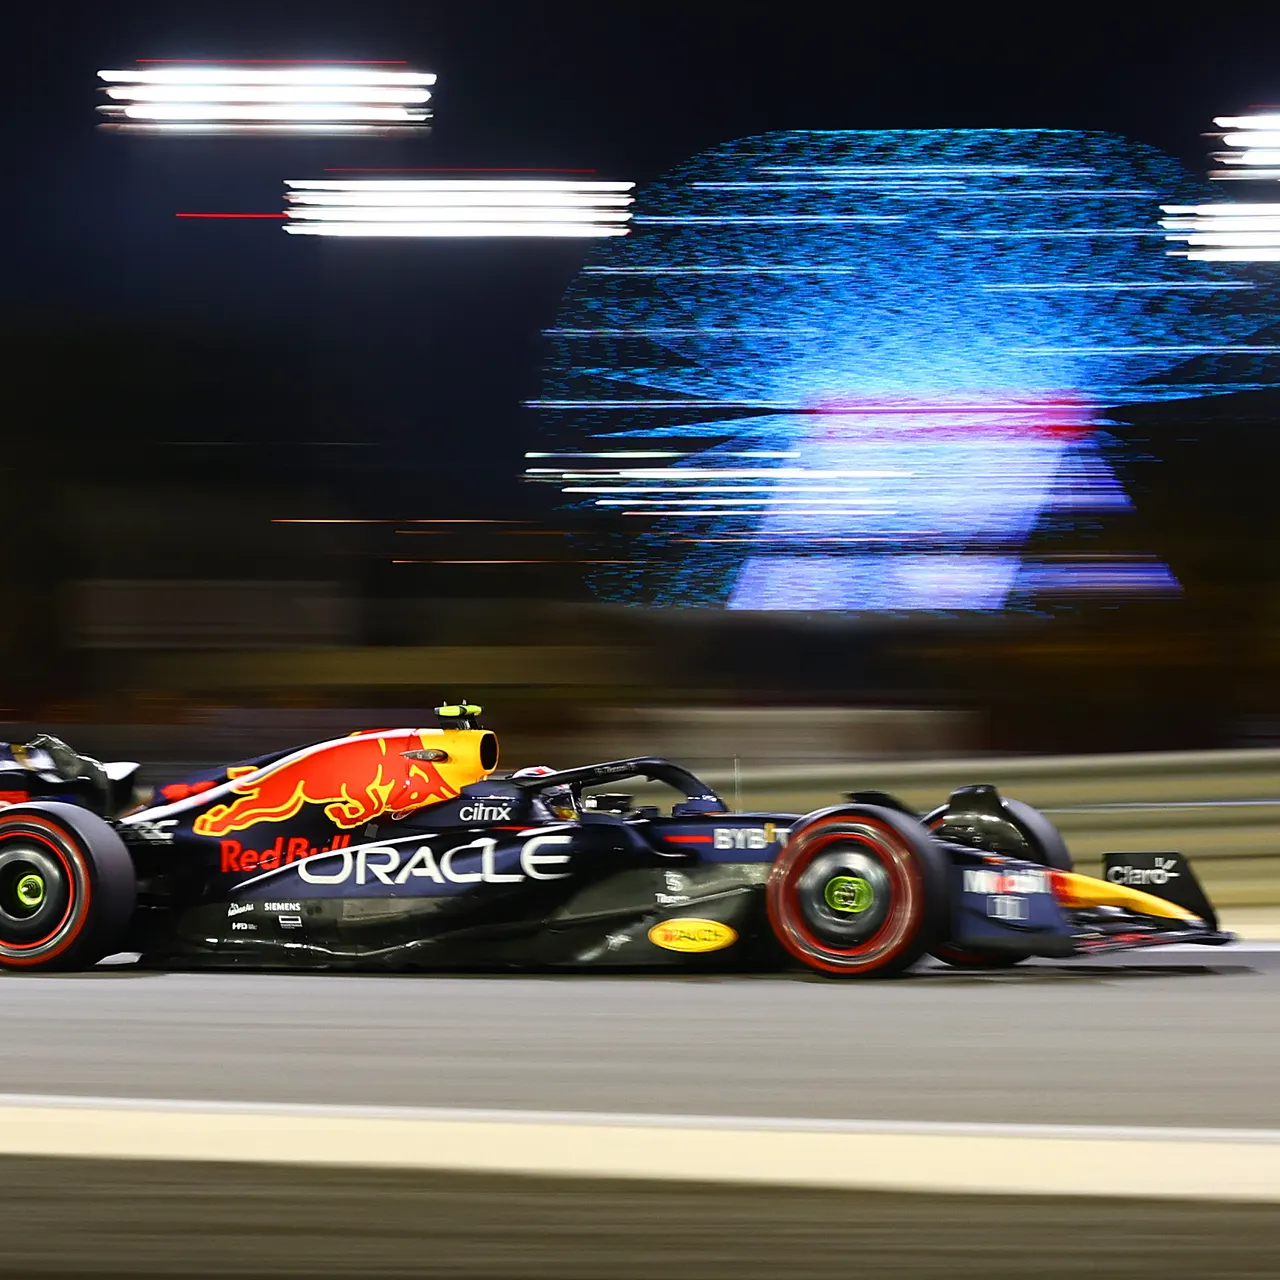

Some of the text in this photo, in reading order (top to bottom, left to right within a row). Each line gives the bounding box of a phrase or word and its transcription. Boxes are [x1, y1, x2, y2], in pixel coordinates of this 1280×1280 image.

[220, 837, 284, 872] Red
[298, 835, 573, 884] ORACLE
[264, 902, 301, 911] SIEMENS
